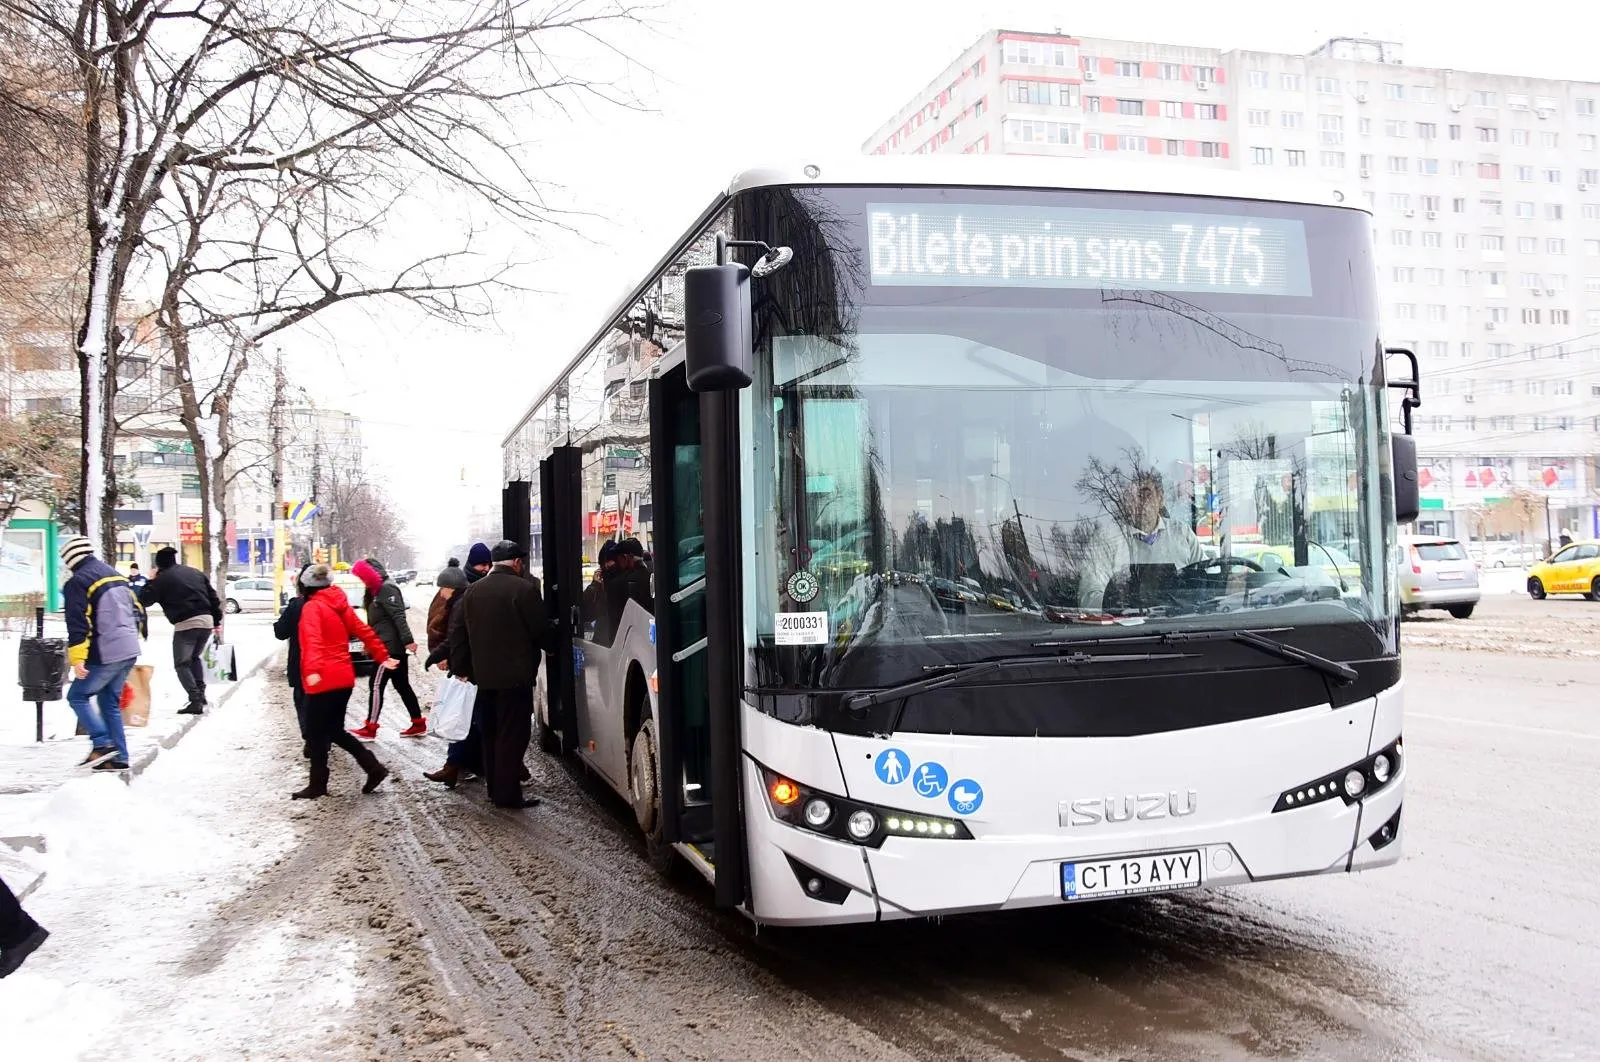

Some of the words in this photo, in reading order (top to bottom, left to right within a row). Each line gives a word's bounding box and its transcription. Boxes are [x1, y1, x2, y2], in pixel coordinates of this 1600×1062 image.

[871, 212, 992, 275] Bilete
[1001, 221, 1078, 280] prin
[1086, 236, 1165, 281] sms
[1171, 222, 1264, 287] 7475
[782, 616, 823, 630] 2000331
[1058, 790, 1196, 827] ISUZU
[1064, 881, 1076, 892] RO
[1082, 865, 1110, 888] CT
[1121, 862, 1141, 885] 13
[1150, 856, 1192, 882] AYY
